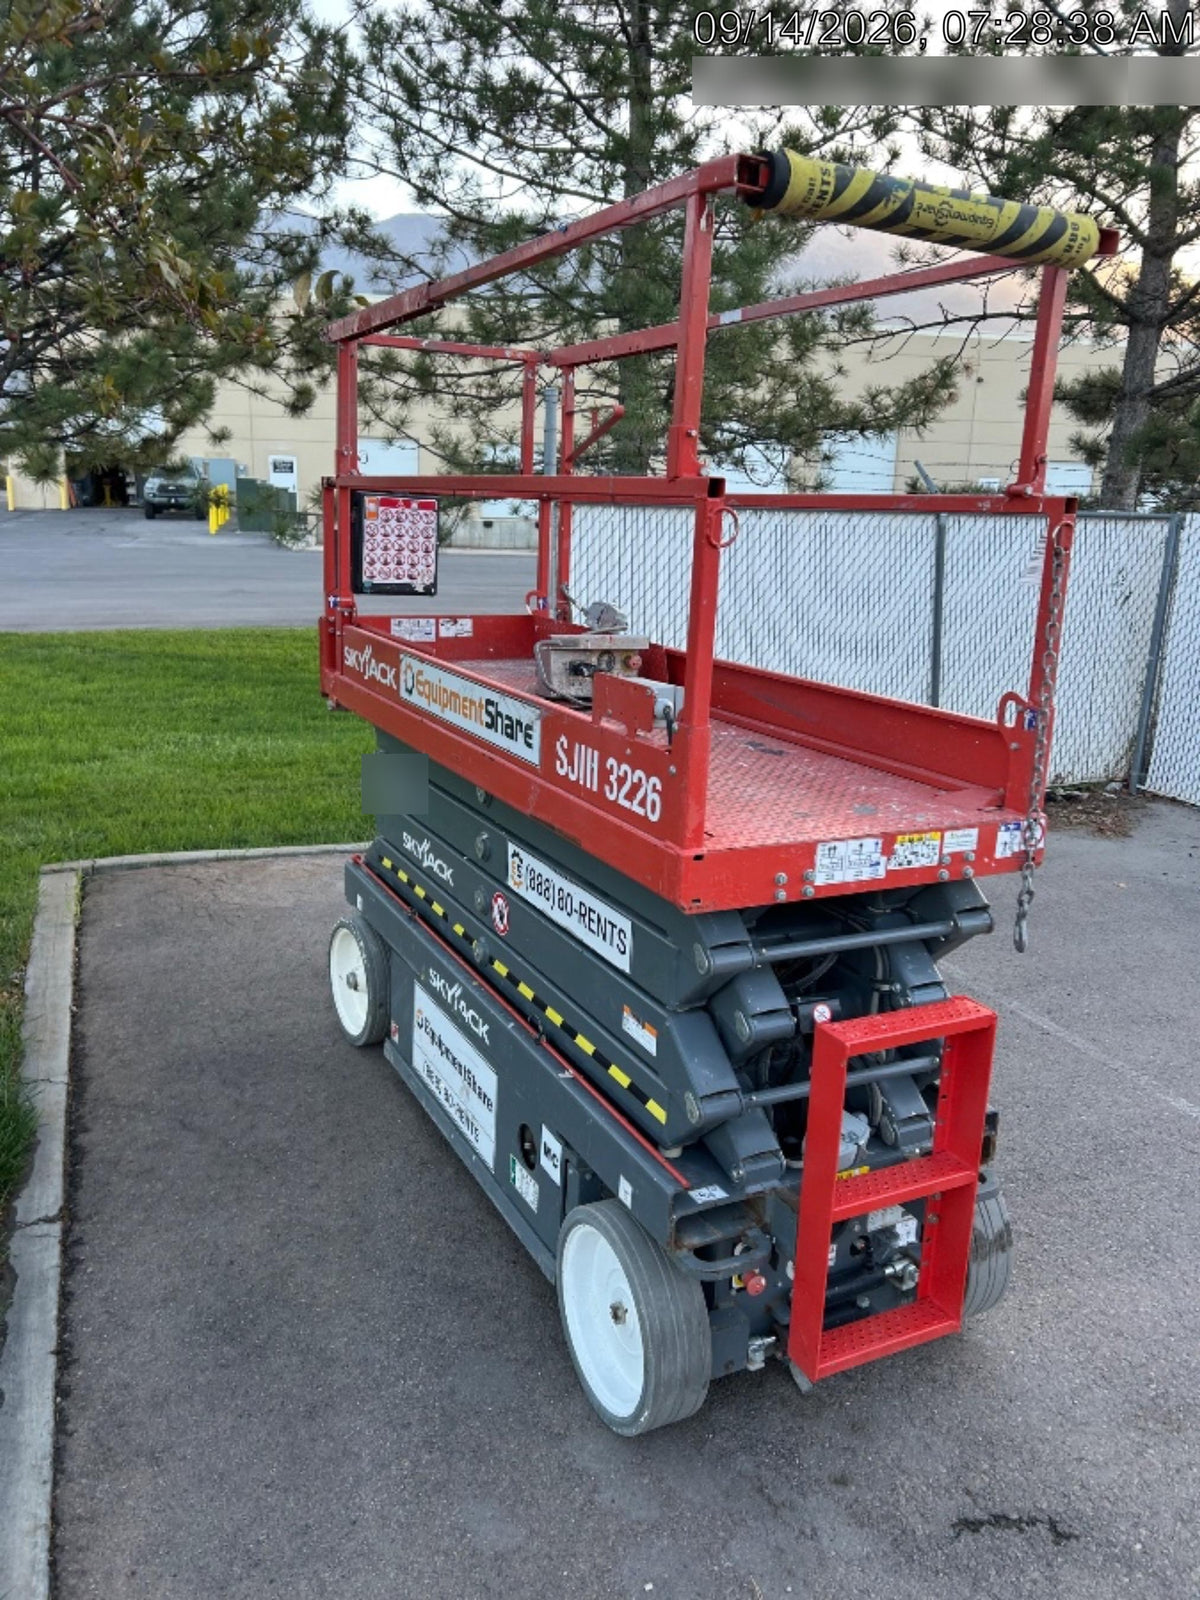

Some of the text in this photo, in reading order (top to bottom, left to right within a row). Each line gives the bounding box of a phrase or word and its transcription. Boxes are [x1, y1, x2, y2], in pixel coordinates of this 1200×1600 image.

[344, 644, 398, 691] SKYJACK
[415, 668, 534, 750] EquipmentShare
[604, 756, 663, 823] 3226
[402, 831, 455, 888] SKYJACK
[429, 967, 491, 1047] SKYJACK
